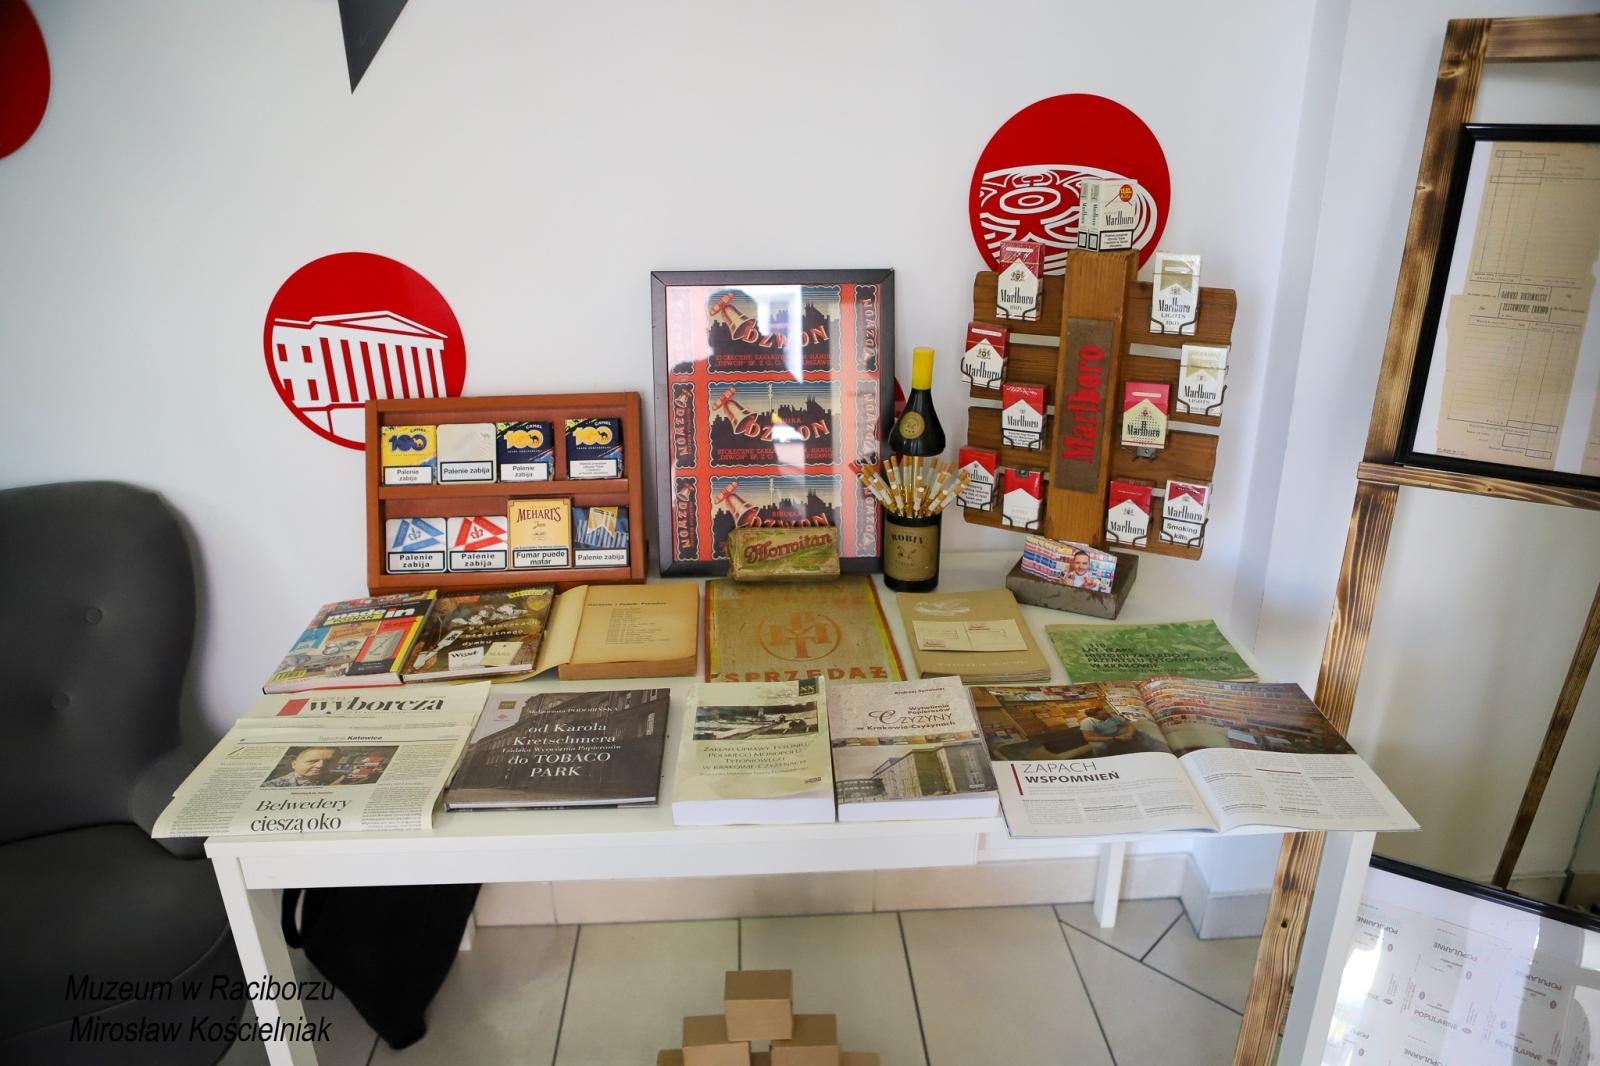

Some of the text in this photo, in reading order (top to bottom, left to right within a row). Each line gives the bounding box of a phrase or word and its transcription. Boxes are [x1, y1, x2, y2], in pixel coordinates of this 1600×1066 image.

[1105, 211, 1134, 226] Marlboro
[1000, 287, 1034, 305] Marlboro
[1158, 297, 1191, 313] Marlboro
[1184, 384, 1217, 400] Marlboro
[1061, 345, 1105, 463] Marlboro
[1007, 412, 1039, 429] Marlboro
[572, 426, 613, 445] 100
[1127, 421, 1161, 438] Marlboro
[388, 434, 428, 452] 100
[503, 429, 544, 449] 100
[470, 467, 490, 475] zabija
[1167, 505, 1202, 521] Marlboro
[1110, 520, 1145, 536] Marlboro
[1166, 522, 1198, 534] Smoking
[1173, 533, 1188, 541] kills
[542, 550, 565, 560] puede
[307, 696, 446, 714] wyborcza
[908, 703, 950, 711] Wytwórnia
[528, 722, 607, 734] od Karola
[512, 735, 617, 747] Kretschmera
[508, 752, 611, 765] do TOBACO
[530, 766, 582, 778] PARK
[1022, 761, 1097, 774] ZAPACH
[1025, 770, 1120, 784] WSPOMNIEŃ
[255, 799, 352, 812] Belwedery
[250, 813, 342, 834] cieszą oko
[1432, 941, 1478, 963] POPULARNE
[1413, 1009, 1459, 1031] POPULARNE
